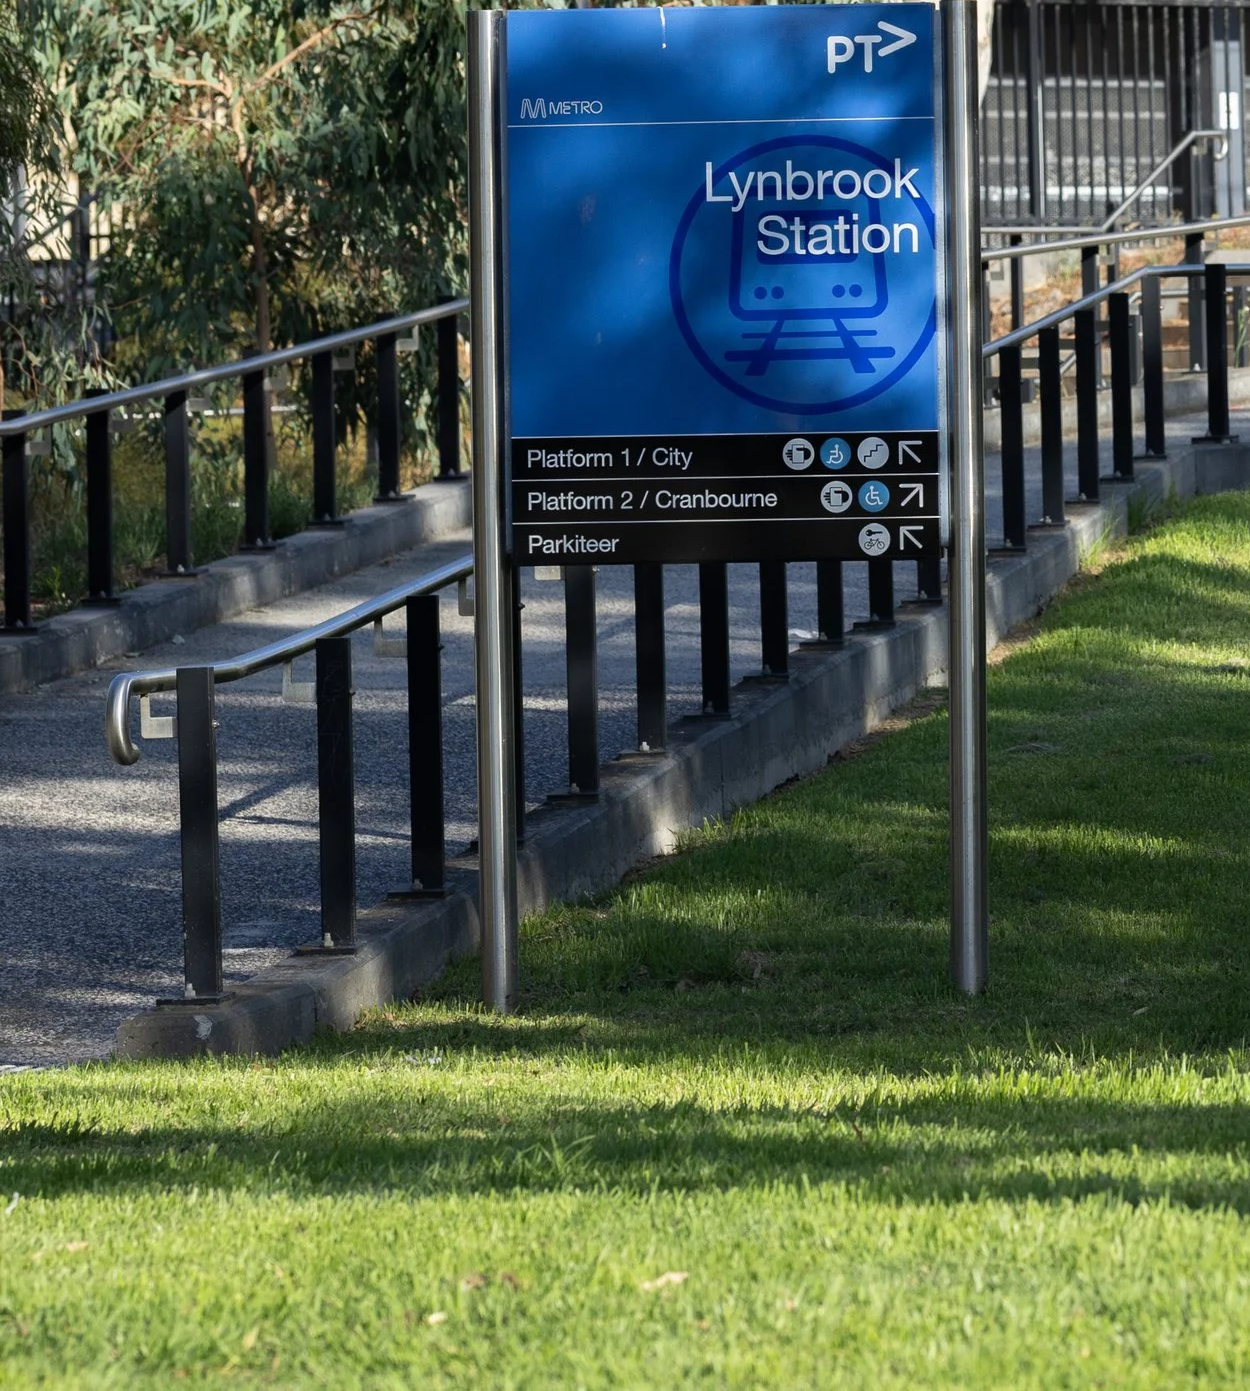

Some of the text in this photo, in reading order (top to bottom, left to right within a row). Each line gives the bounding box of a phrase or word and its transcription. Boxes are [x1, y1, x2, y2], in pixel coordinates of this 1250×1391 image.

[549, 100, 603, 115] METRO
[705, 159, 921, 212] Lynbrook
[757, 214, 919, 256] Station
[527, 447, 693, 471] Platform 1 / City
[527, 489, 778, 511] Platform 2 / Cranbourne
[528, 535, 620, 554] Parkiteer
